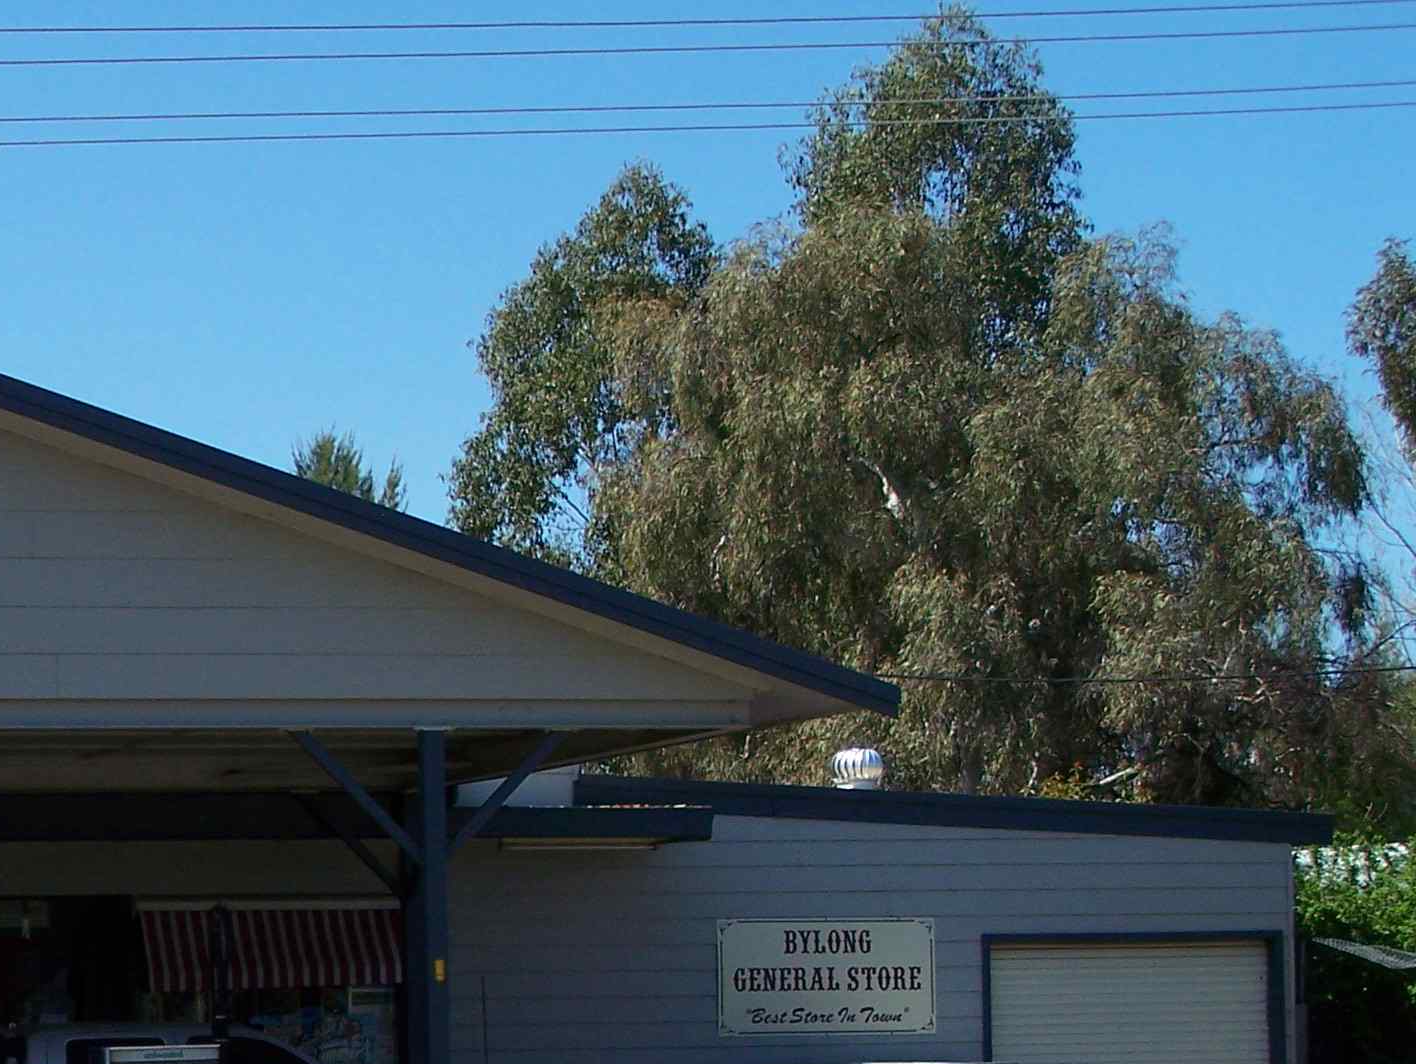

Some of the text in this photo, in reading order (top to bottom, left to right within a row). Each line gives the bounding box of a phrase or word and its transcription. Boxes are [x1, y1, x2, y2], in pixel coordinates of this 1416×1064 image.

[784, 930, 872, 954] BYLONG
[733, 966, 922, 992] GENERAL STORE
[790, 1008, 834, 1024] Store
[838, 1007, 857, 1024] In
